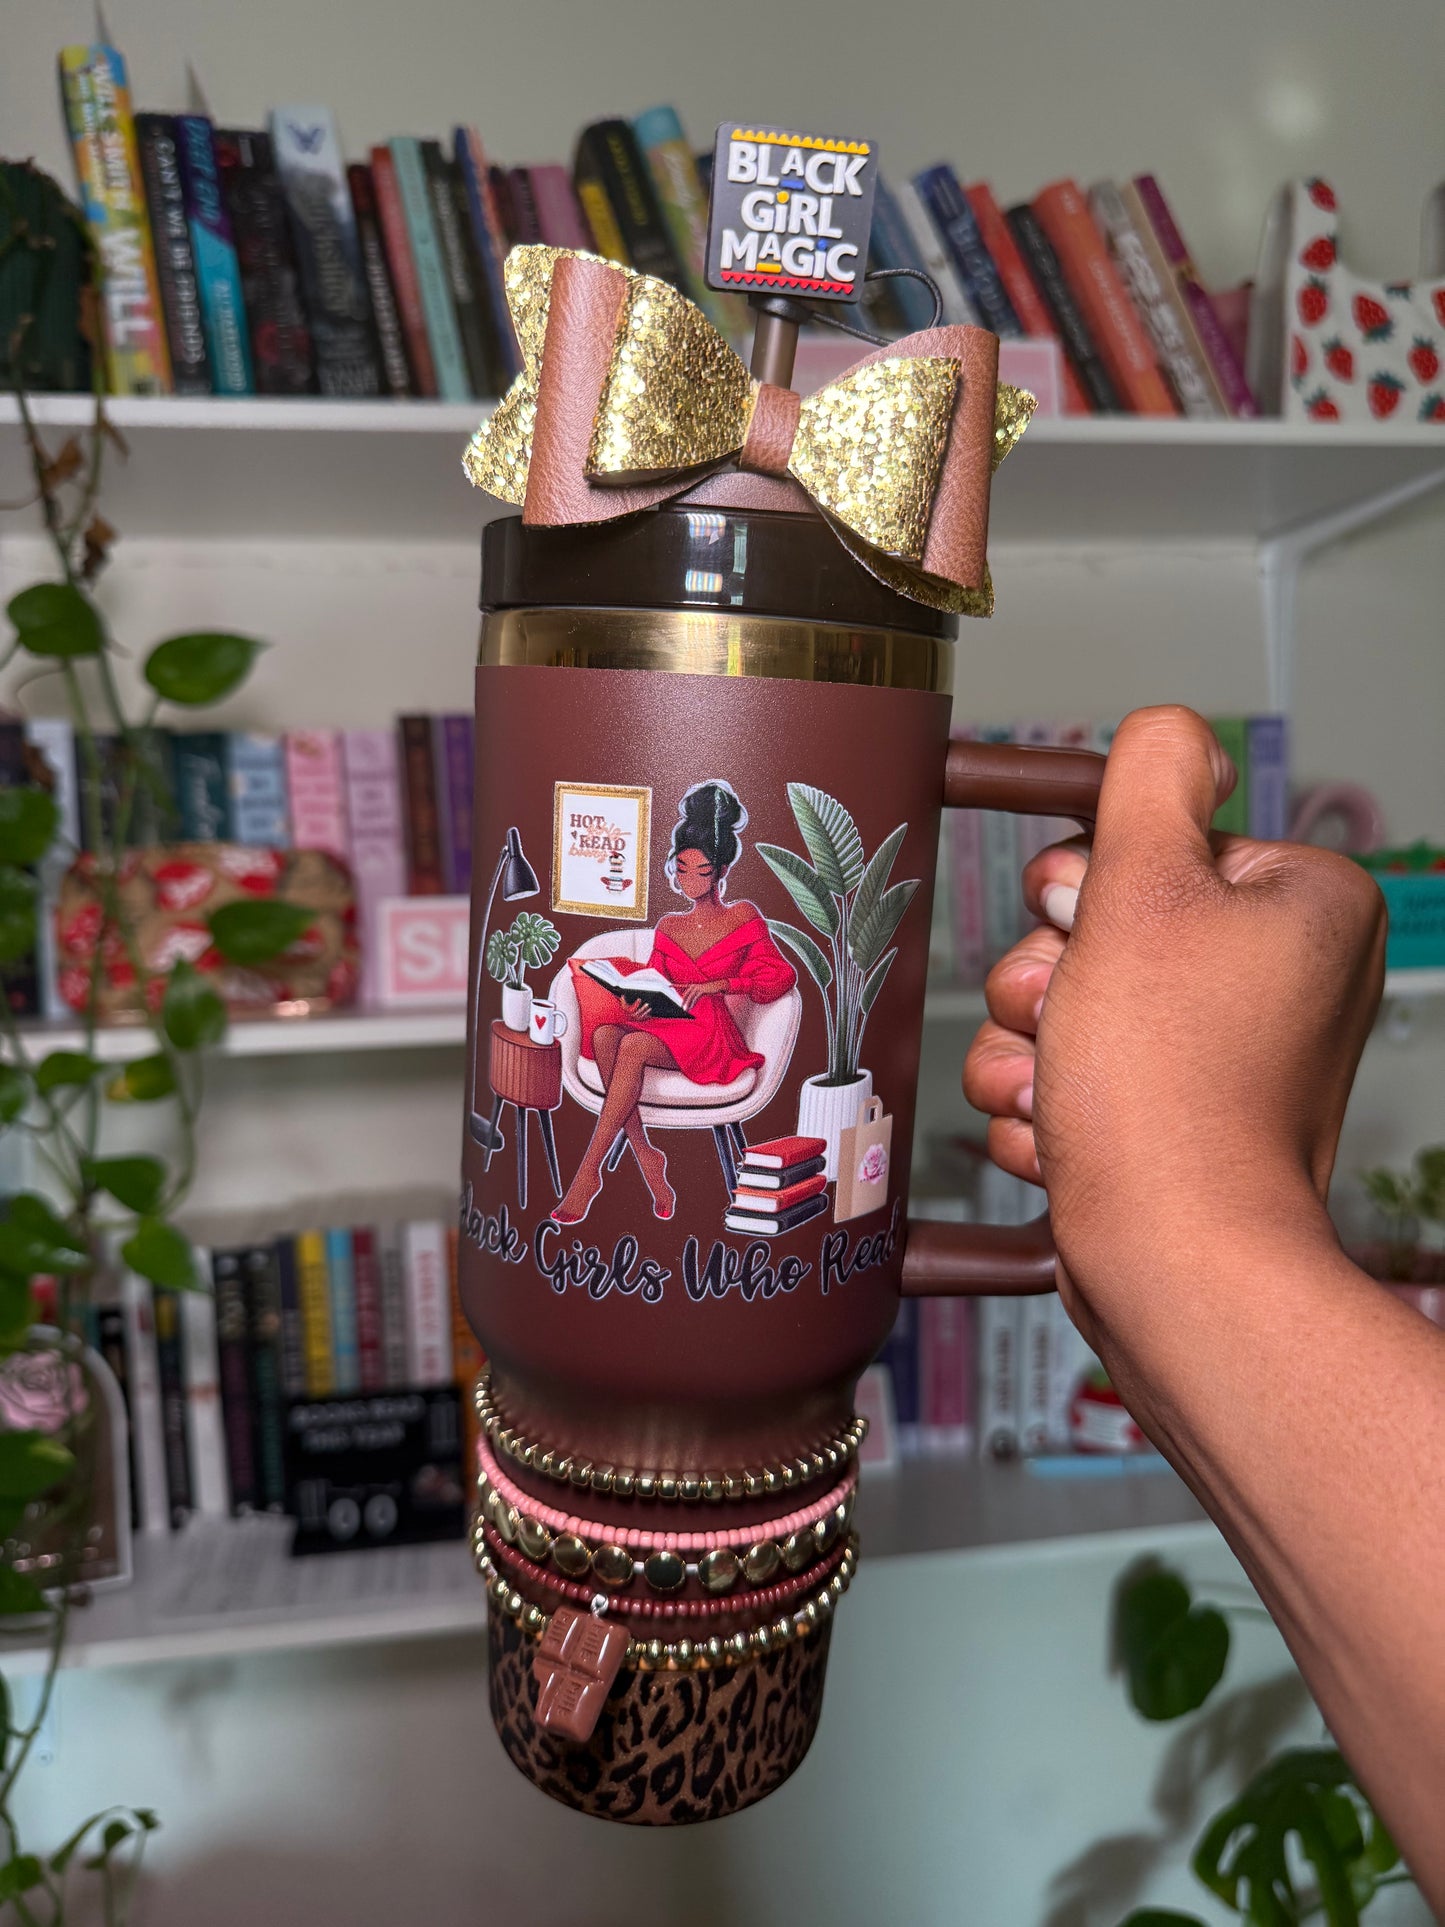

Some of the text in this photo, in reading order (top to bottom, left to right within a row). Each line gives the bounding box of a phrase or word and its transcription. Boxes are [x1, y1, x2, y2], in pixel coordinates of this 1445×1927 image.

[727, 141, 868, 196] BLACK
[101, 228, 154, 346] WILL
[569, 813, 605, 829] HOT
[579, 834, 626, 852] READ
[534, 1219, 672, 1304] Girls
[682, 1236, 812, 1302] Who
[820, 1196, 901, 1296] Read
